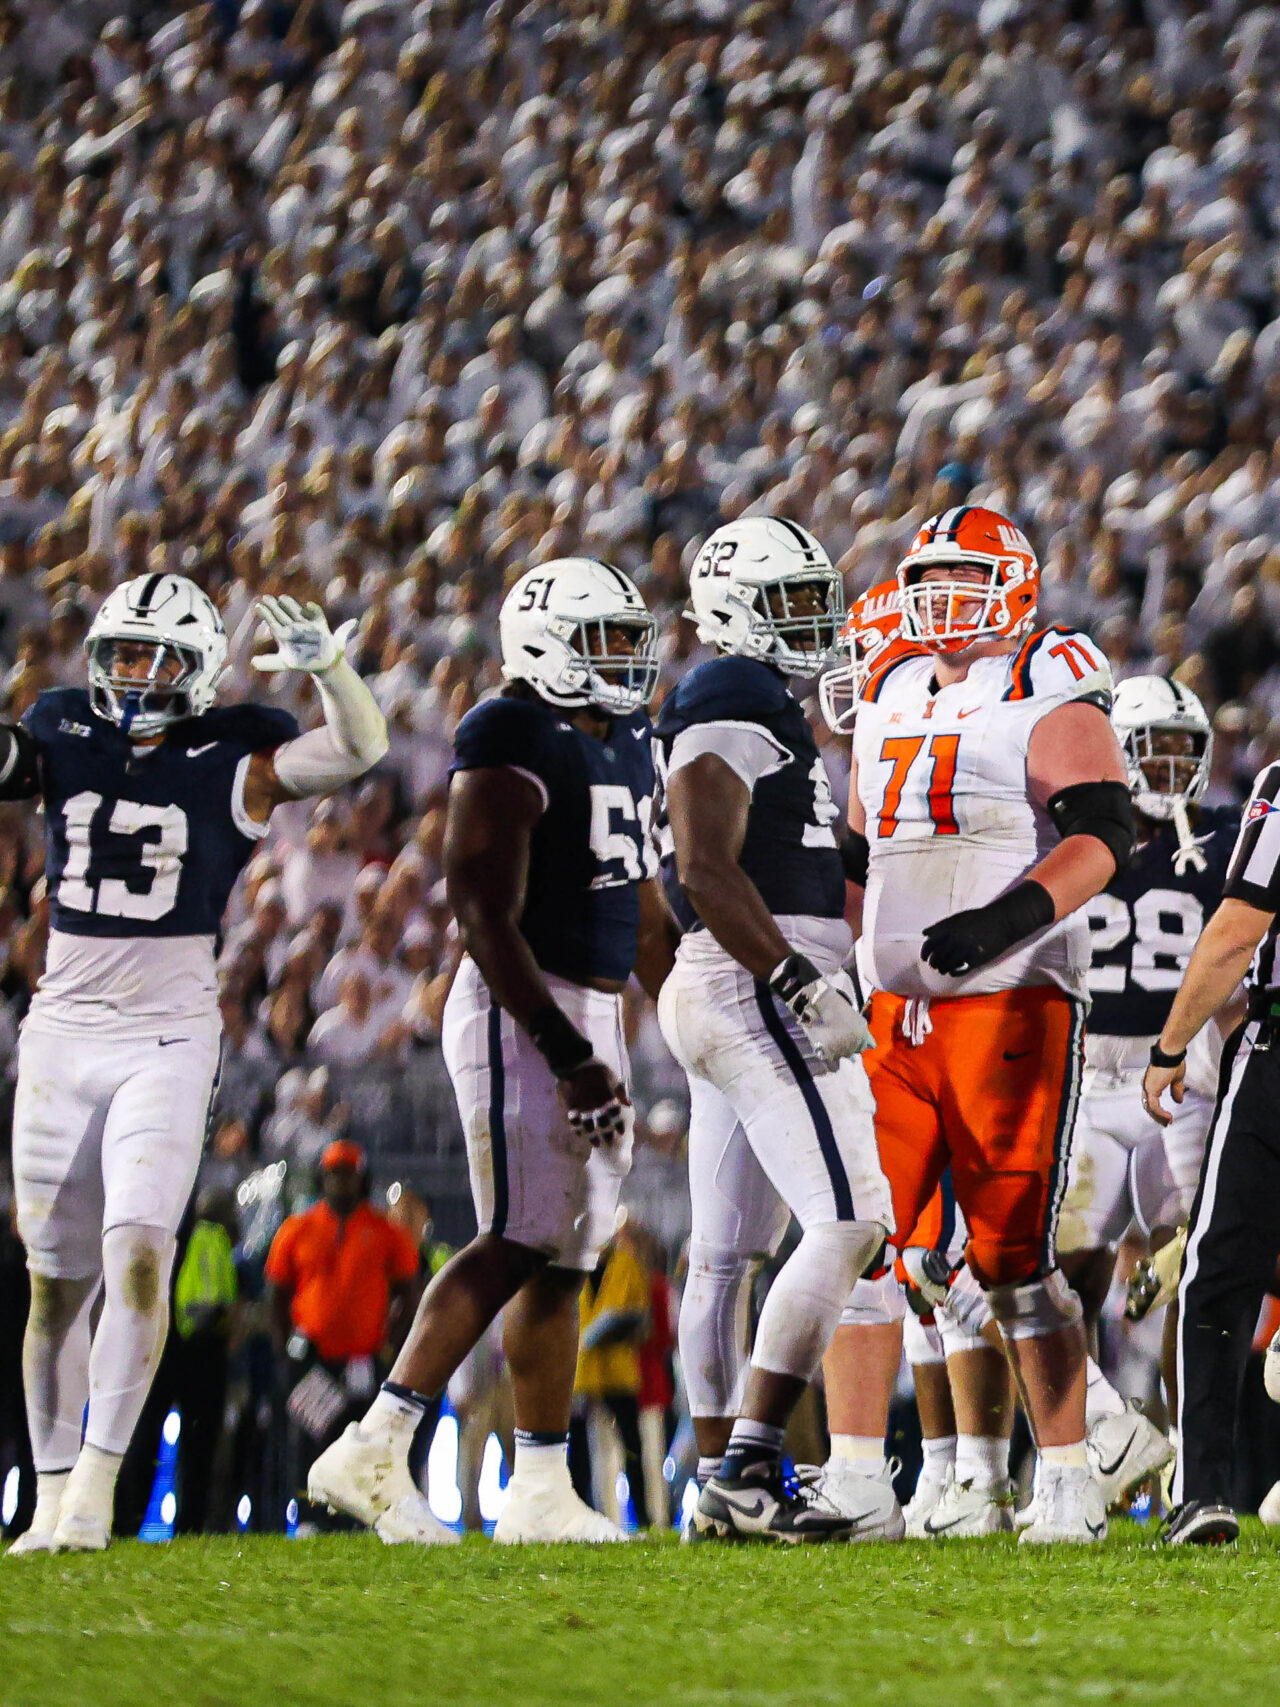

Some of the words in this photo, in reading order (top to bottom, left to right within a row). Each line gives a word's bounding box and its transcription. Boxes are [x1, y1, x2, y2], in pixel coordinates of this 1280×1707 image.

[518, 577, 556, 611] 51
[1049, 639, 1099, 681] 71
[588, 784, 659, 890] 51
[877, 733, 961, 839] 71
[57, 790, 189, 922] 13
[1085, 888, 1204, 993] 28
